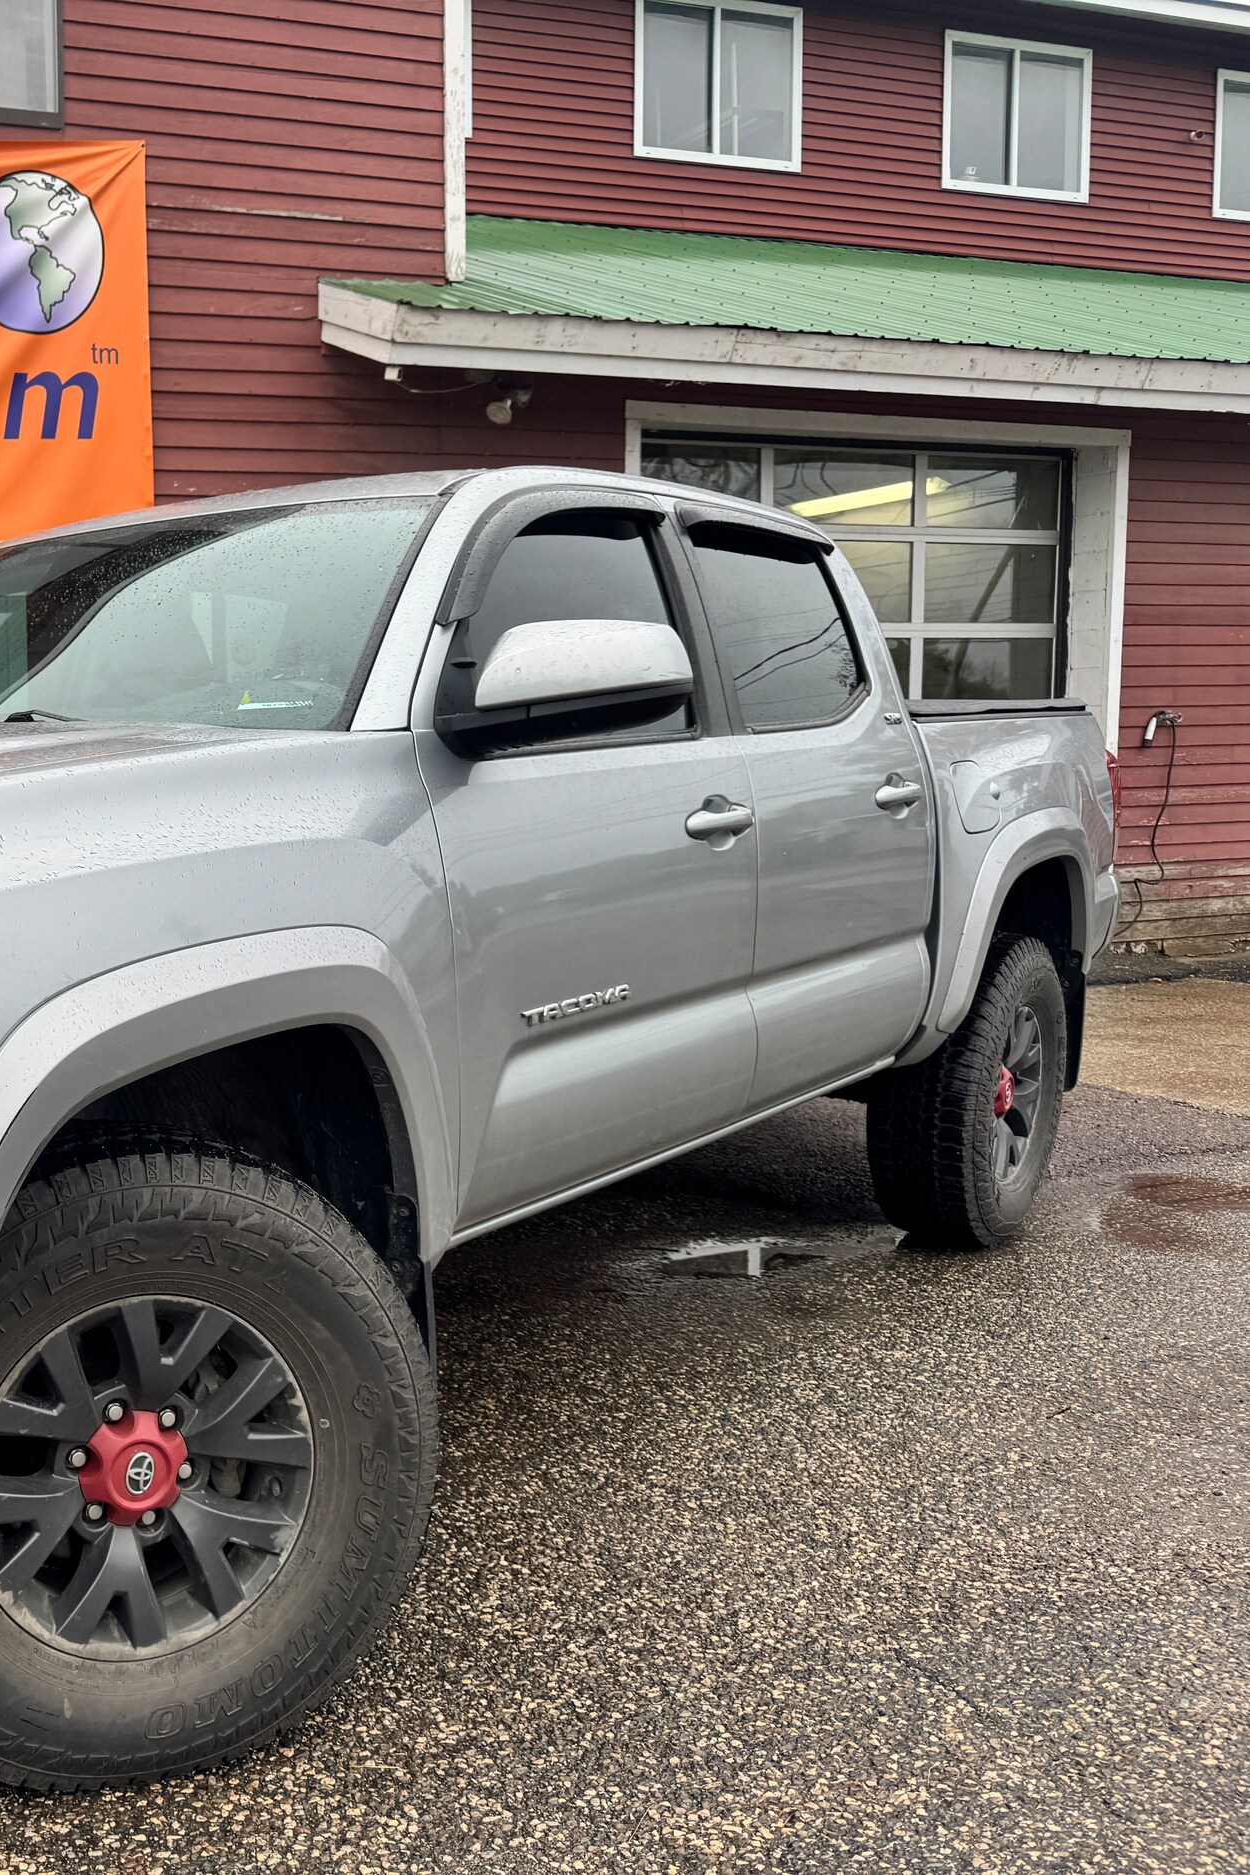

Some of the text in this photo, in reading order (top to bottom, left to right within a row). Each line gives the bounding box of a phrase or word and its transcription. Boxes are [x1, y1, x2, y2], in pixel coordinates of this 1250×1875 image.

[91, 342, 119, 365] tm
[520, 983, 632, 1027] TACOMA
[170, 1233, 269, 1273] AT
[144, 1442, 389, 1740] SUMITOMO
